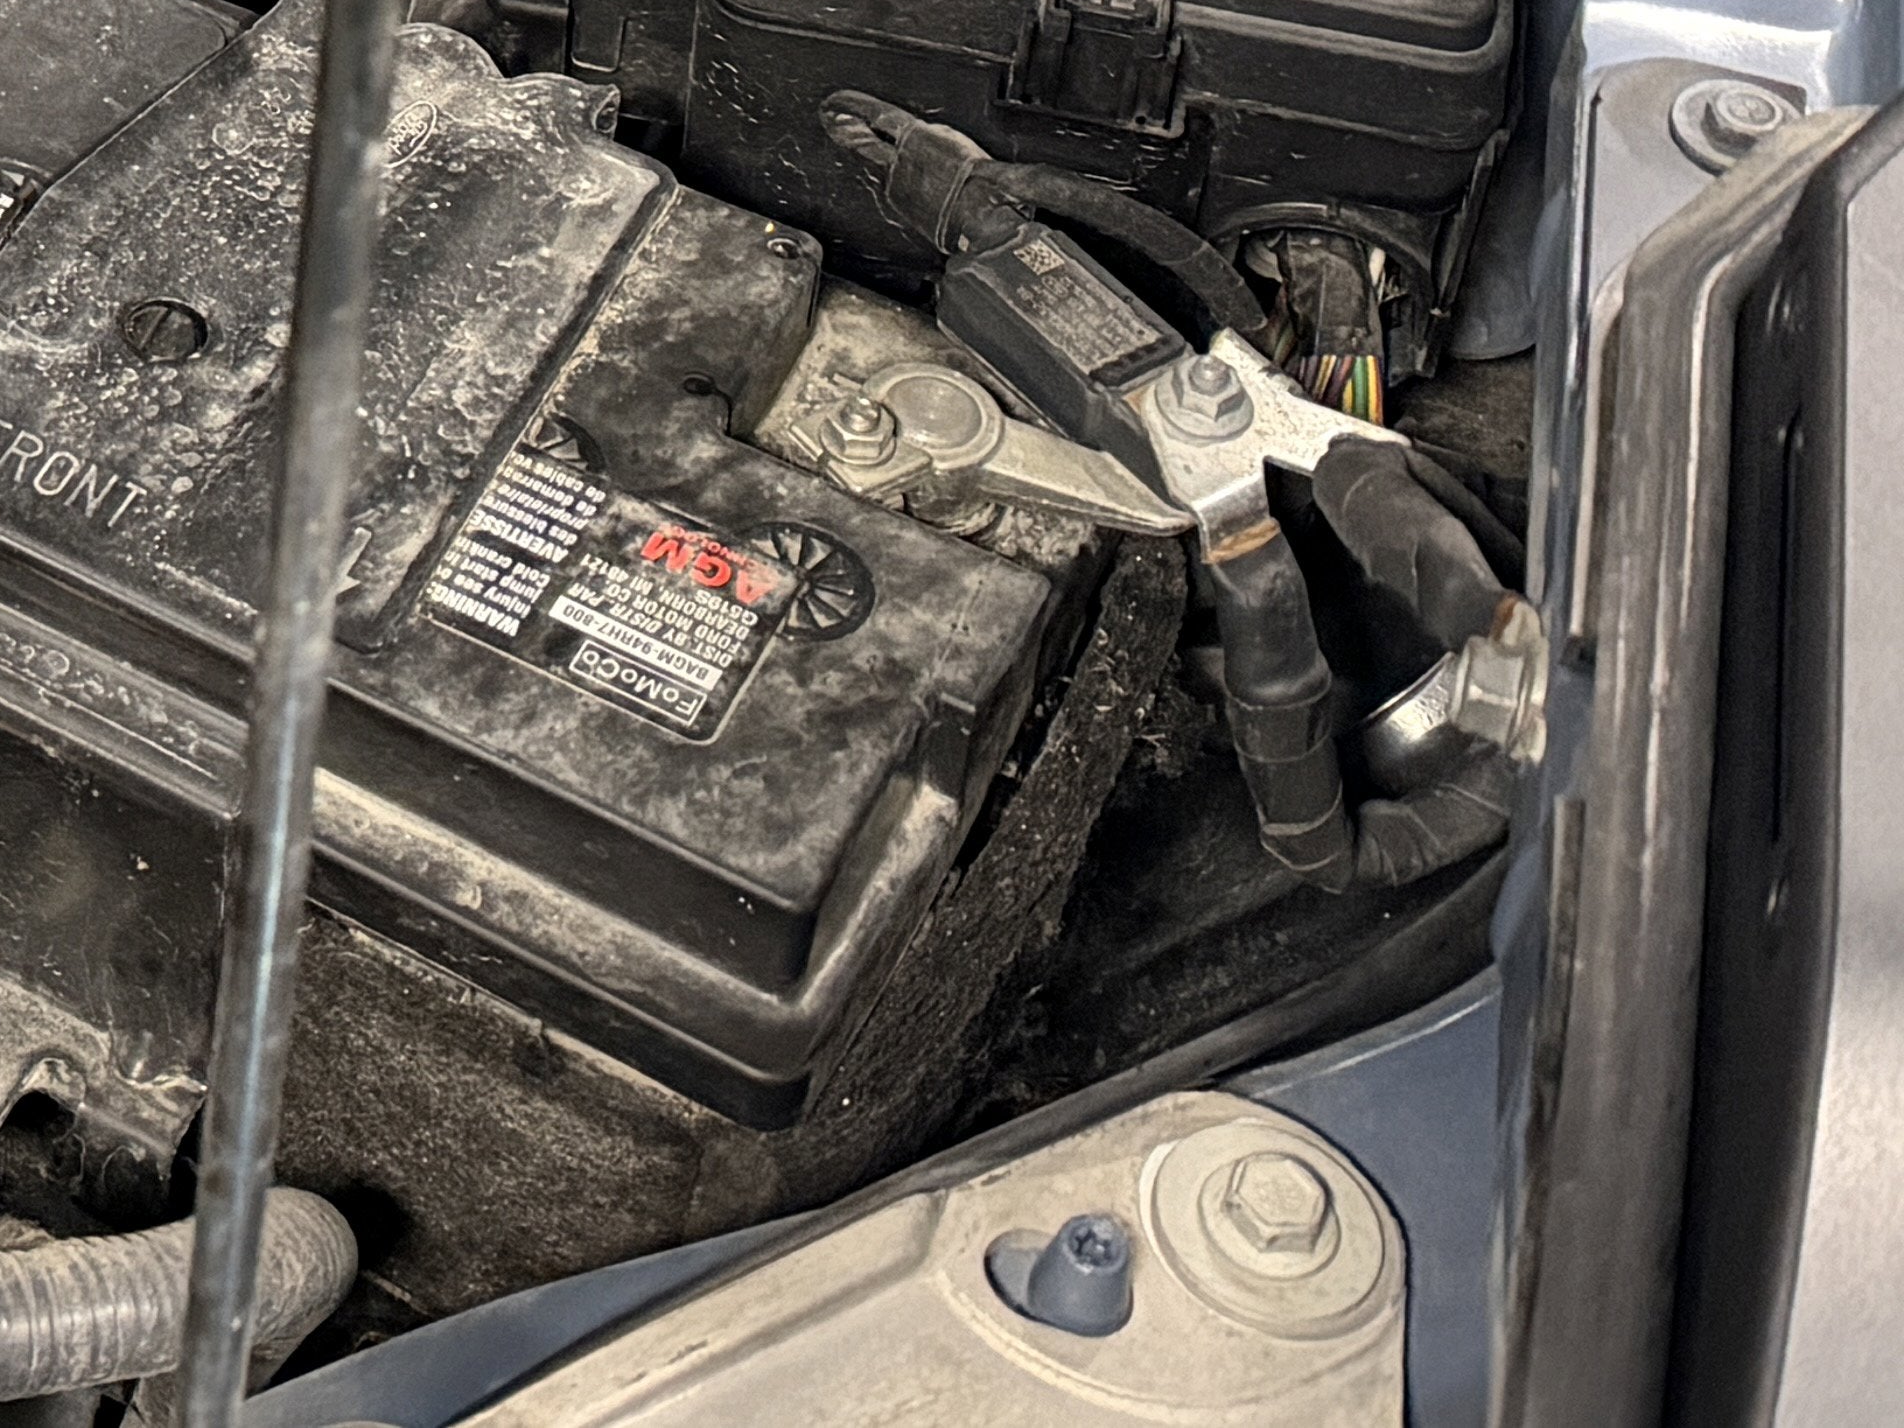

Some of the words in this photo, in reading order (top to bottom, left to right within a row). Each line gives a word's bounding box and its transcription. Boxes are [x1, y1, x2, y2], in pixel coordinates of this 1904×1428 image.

[573, 499, 597, 517] de
[582, 485, 607, 504] de
[545, 524, 579, 548] des
[458, 556, 500, 583] start
[510, 561, 552, 588] Cold
[579, 551, 631, 583] 48121
[637, 528, 776, 612] AGM
[452, 573, 484, 595] see
[565, 581, 605, 607] PAR
[599, 579, 633, 603] CO.
[628, 575, 654, 595] MI
[421, 580, 523, 637] WARNING:
[630, 594, 694, 631] MOTOR
[652, 585, 751, 641] DEARBORN,
[661, 625, 688, 646] BY
[692, 622, 742, 654] FORD
[576, 646, 700, 716] FoMoCo
